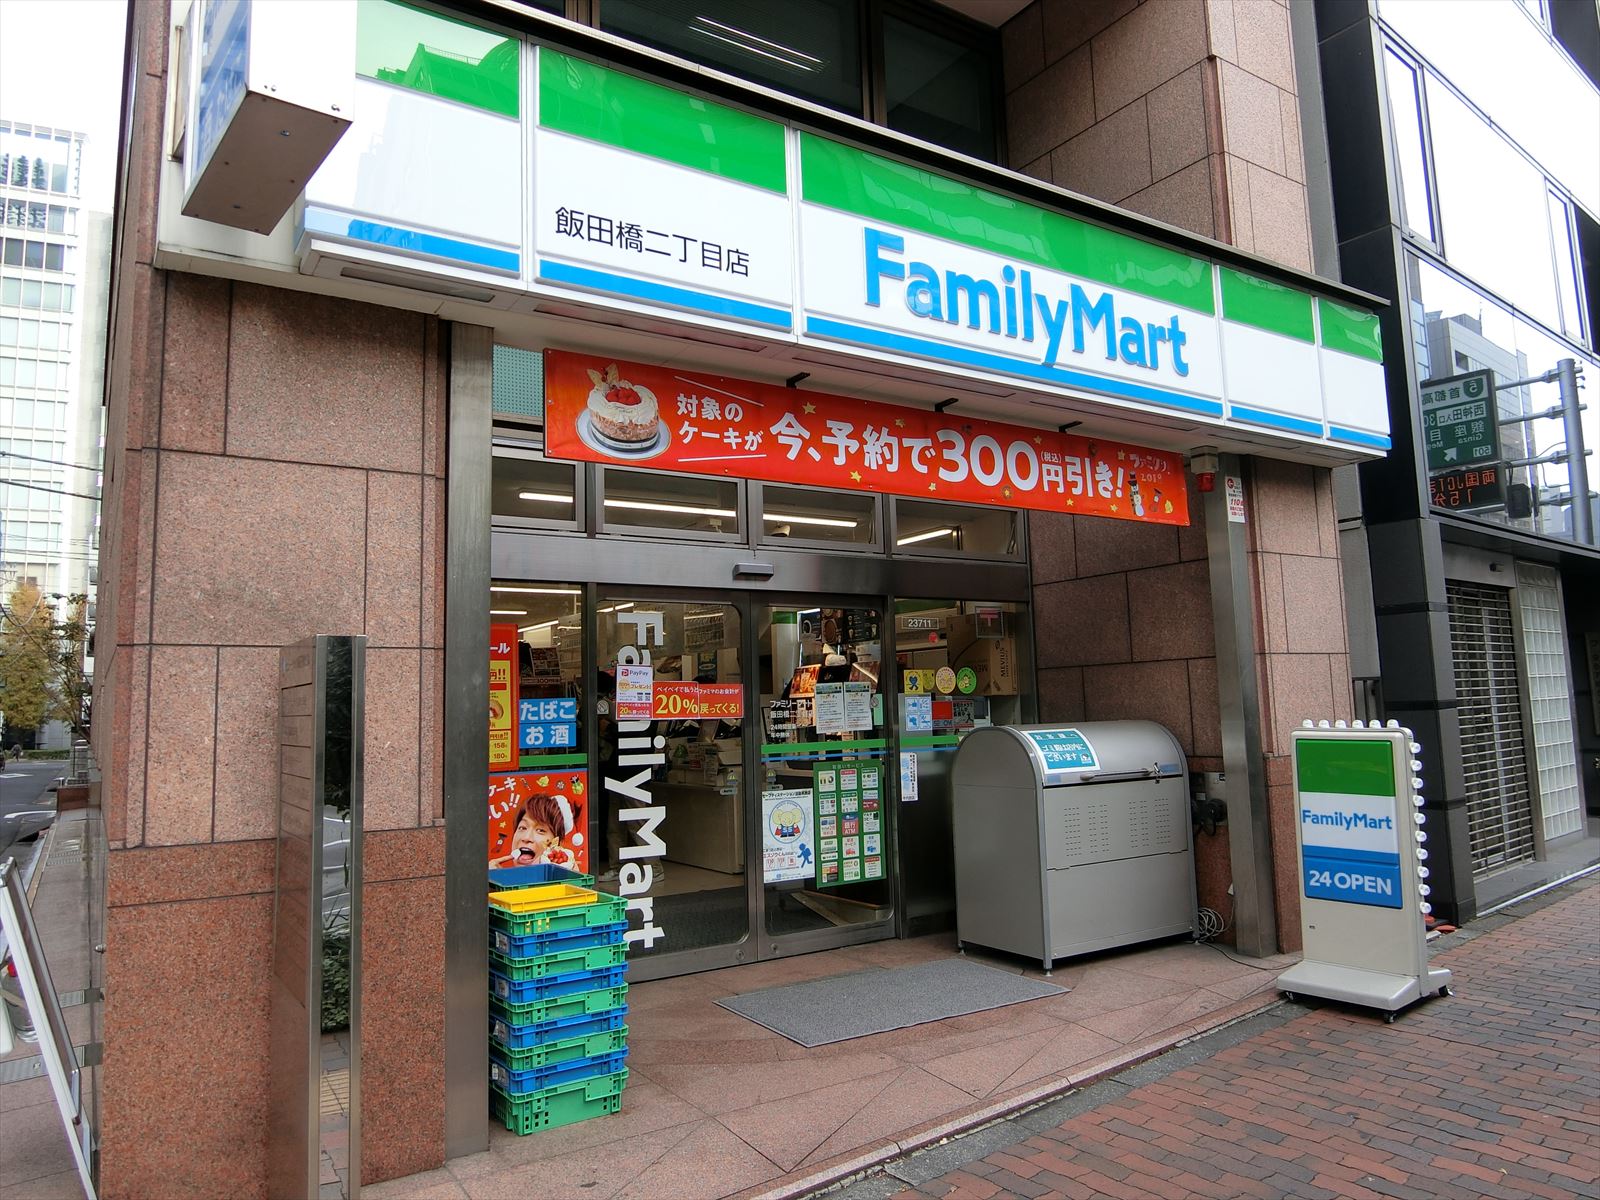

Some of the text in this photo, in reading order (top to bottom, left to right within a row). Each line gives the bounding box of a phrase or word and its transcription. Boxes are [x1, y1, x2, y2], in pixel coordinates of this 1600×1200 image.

[555, 206, 749, 277] 飯田橋二丁目店
[864, 226, 1189, 377] FamilyMart
[676, 392, 744, 423] 対象の
[679, 420, 764, 452] ケーキが
[908, 618, 932, 628] 23711
[520, 700, 576, 721] たばこ
[655, 694, 699, 715] 20%
[526, 725, 570, 745] お酒
[604, 612, 668, 951] FailyMart
[1302, 809, 1393, 831] FamilyMart
[1309, 869, 1393, 896] 24 OPEN
